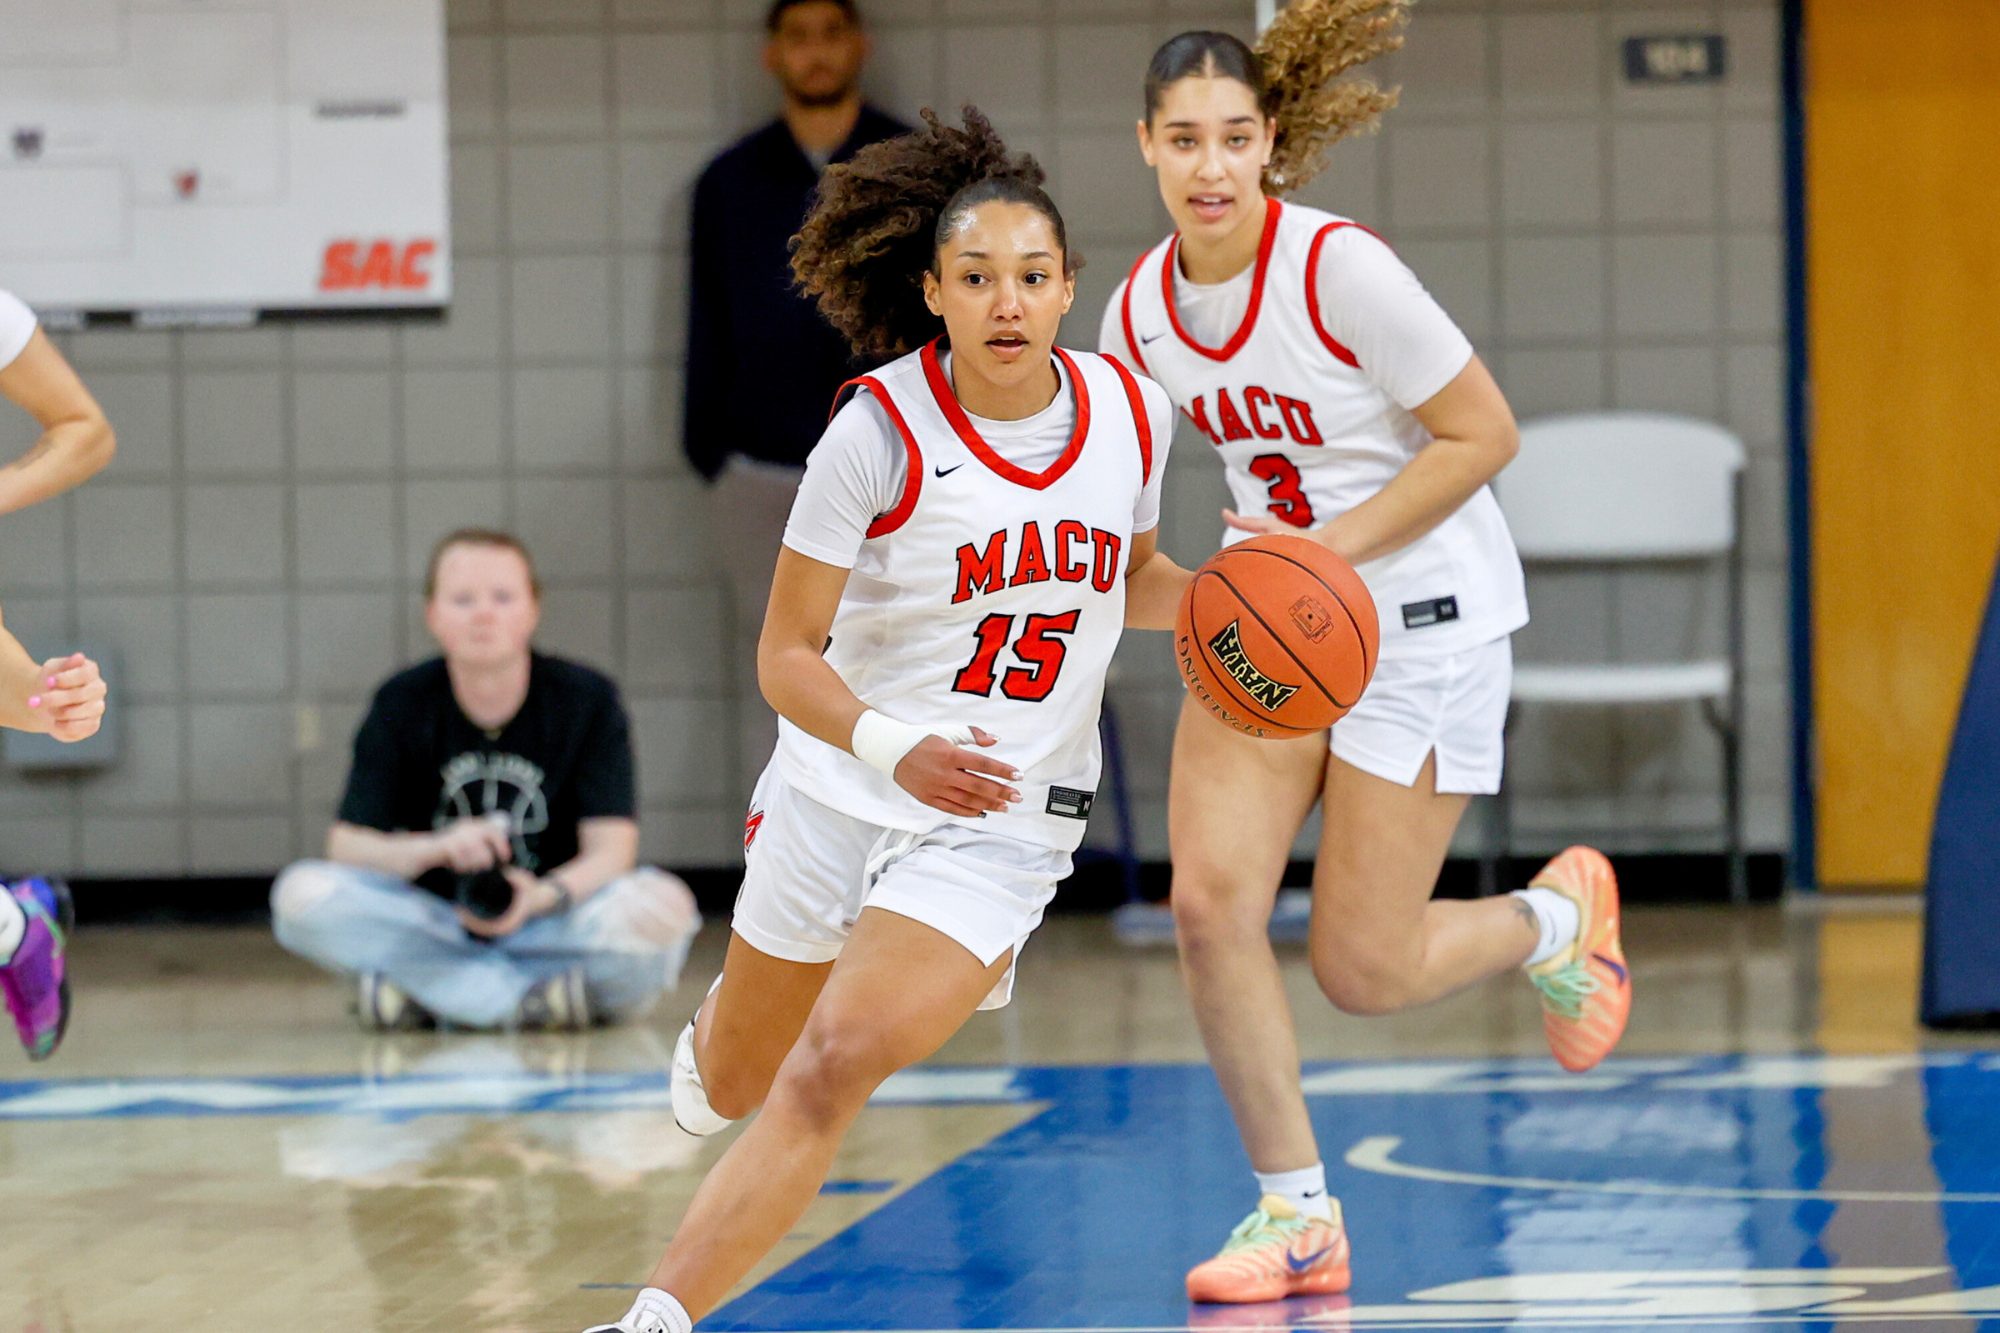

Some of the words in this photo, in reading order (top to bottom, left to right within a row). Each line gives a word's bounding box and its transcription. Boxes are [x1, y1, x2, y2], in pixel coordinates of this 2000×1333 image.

[318, 237, 437, 291] SAC
[1248, 453, 1316, 528] 3
[951, 519, 1122, 605] MACU
[950, 608, 1082, 703] 15
[1177, 635, 1273, 738] SPALDING
[1207, 617, 1302, 713] NAIA
